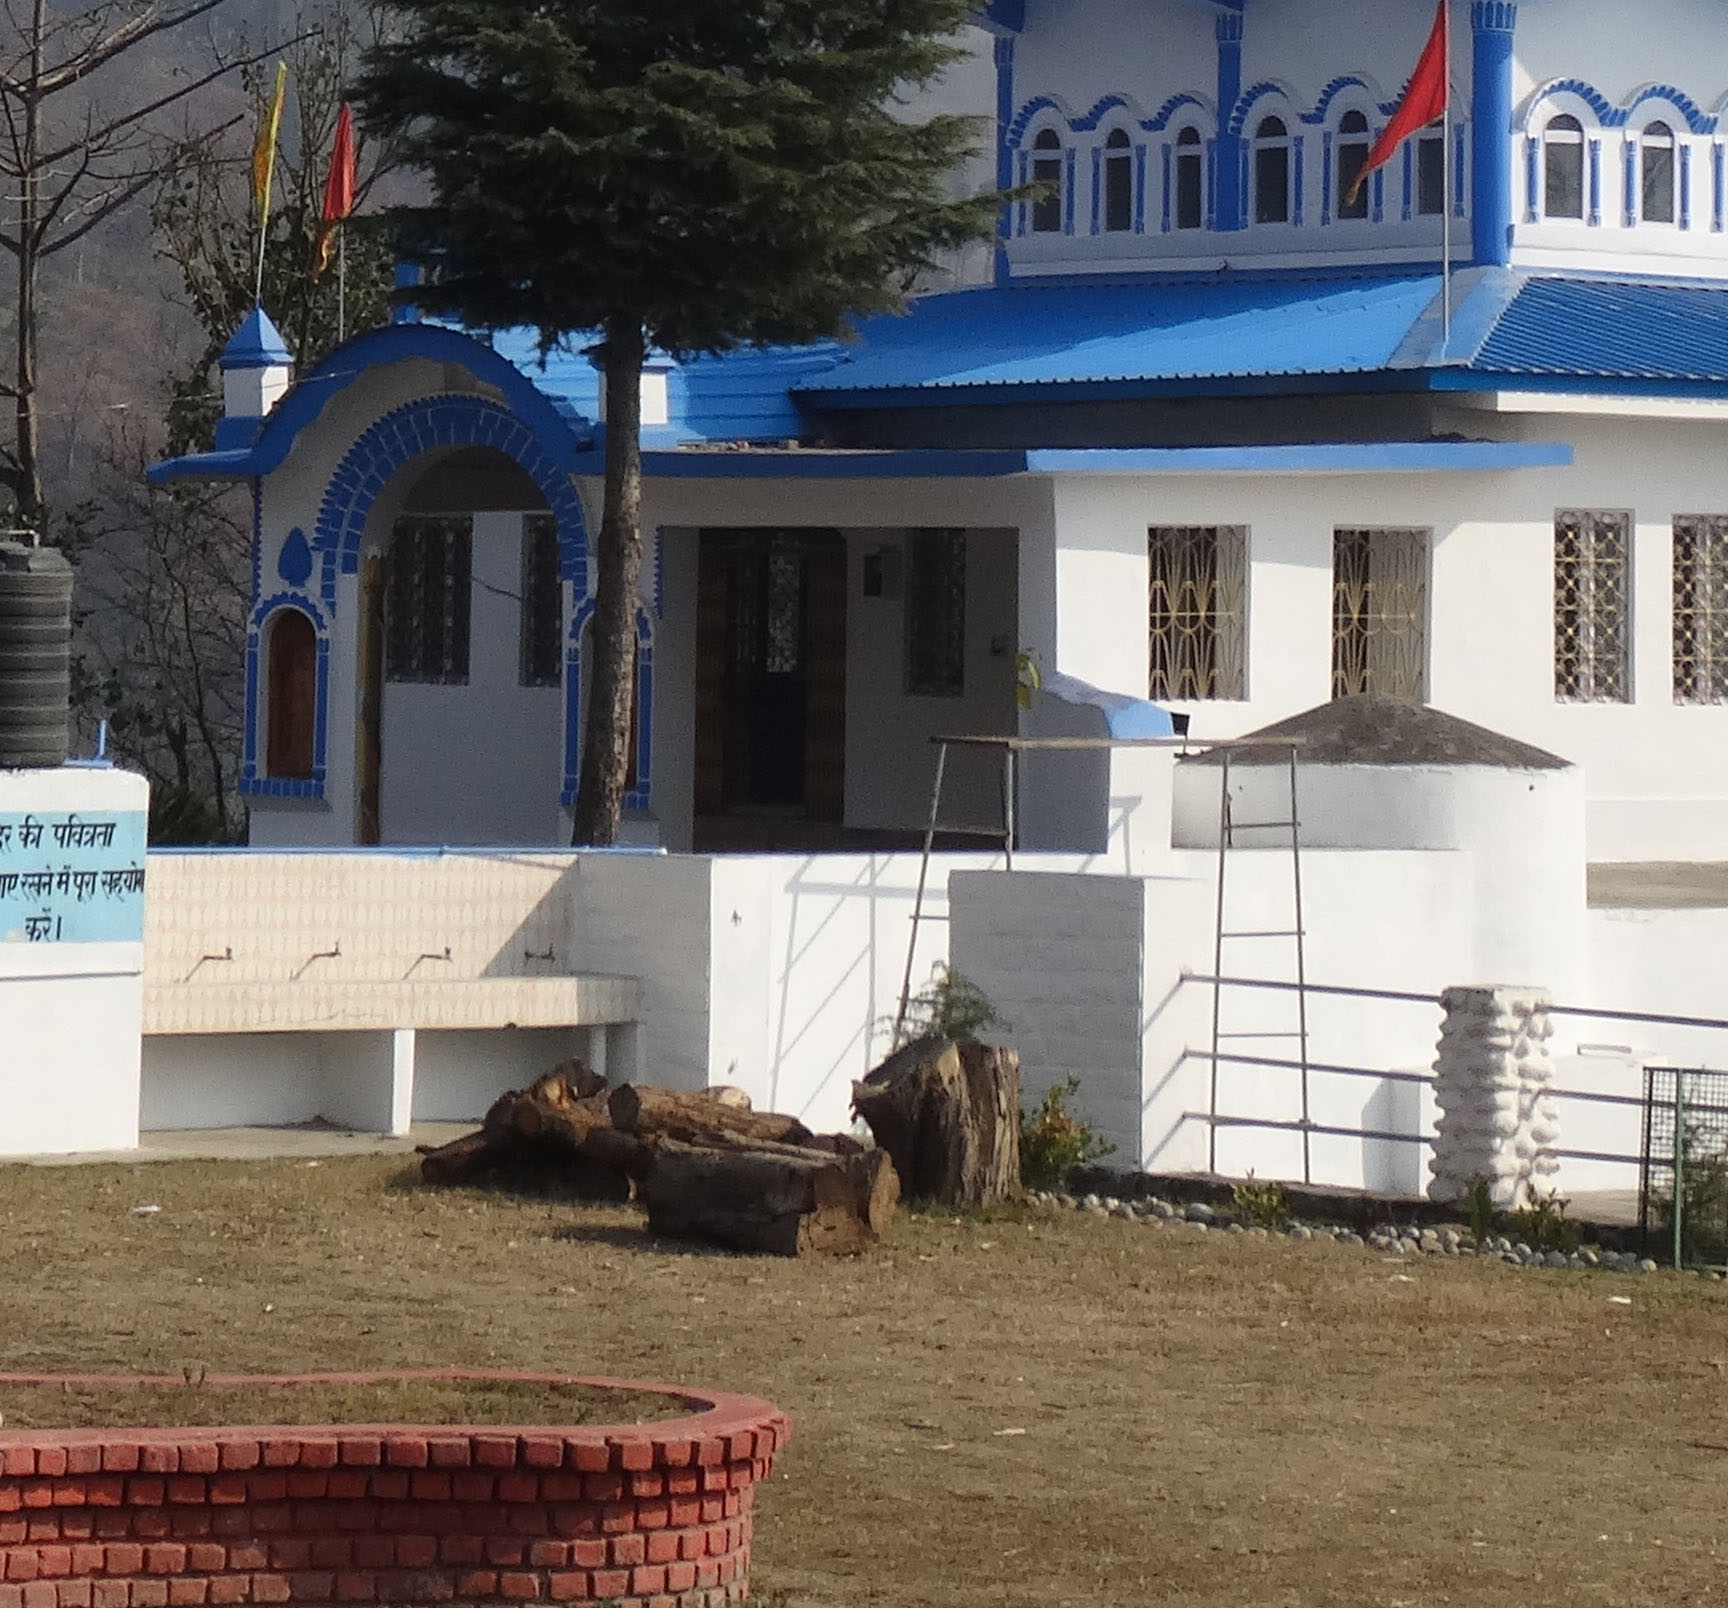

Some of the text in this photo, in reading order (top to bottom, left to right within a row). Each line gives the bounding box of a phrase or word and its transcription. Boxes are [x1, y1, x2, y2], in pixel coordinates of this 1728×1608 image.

[19, 814, 44, 849] की
[52, 813, 116, 849] पवित्रता
[56, 864, 71, 895] में
[73, 871, 98, 903] पूरा
